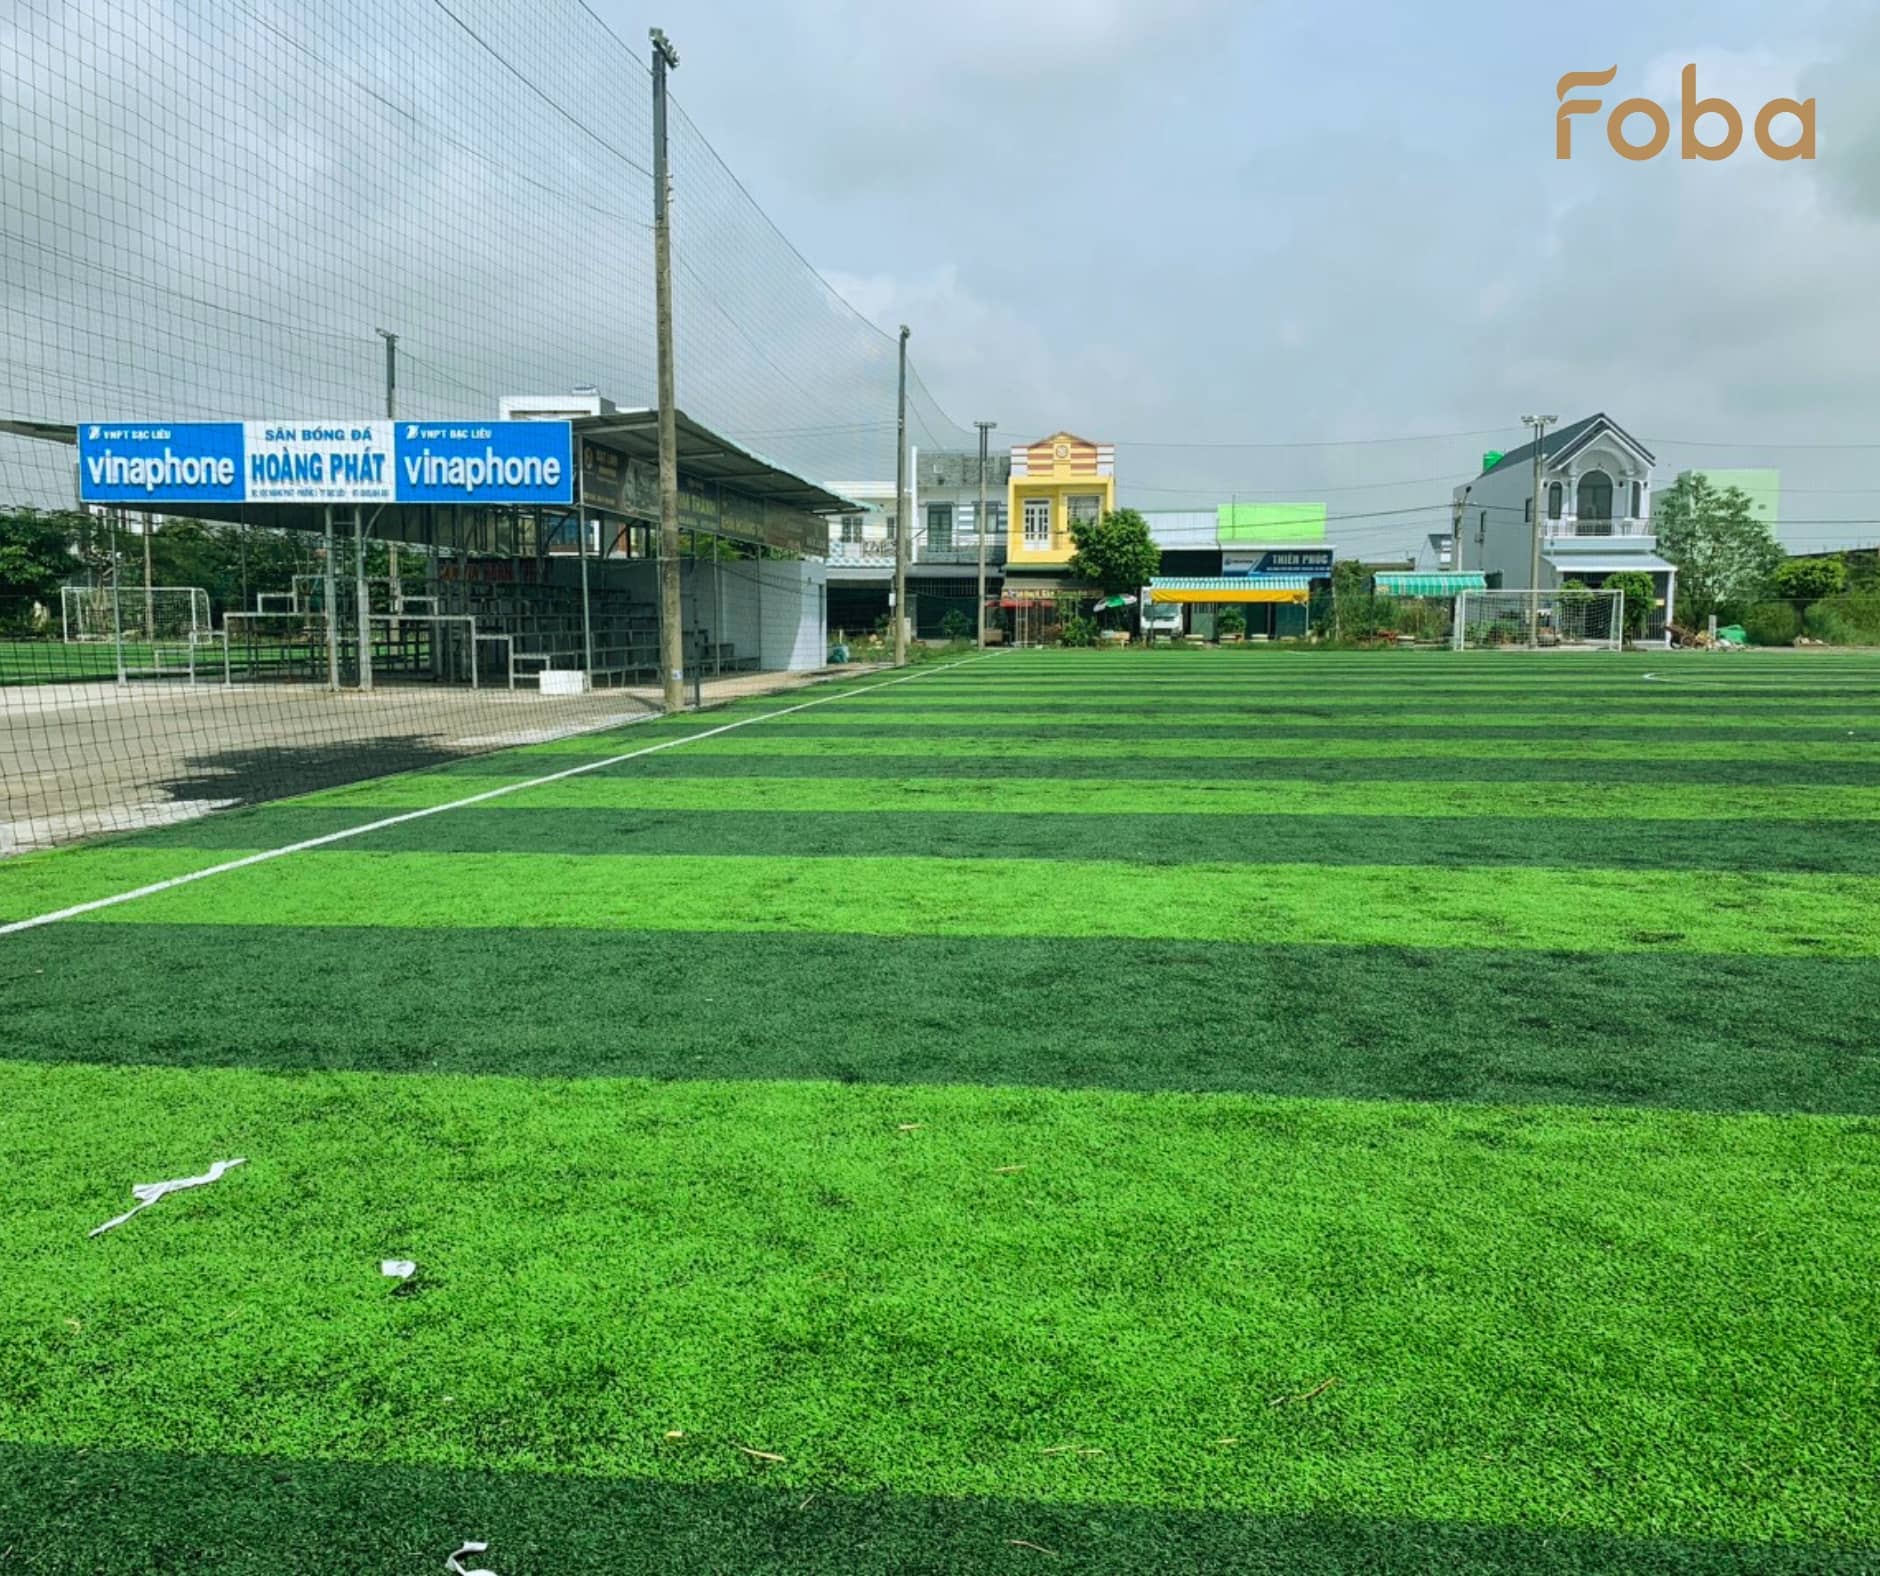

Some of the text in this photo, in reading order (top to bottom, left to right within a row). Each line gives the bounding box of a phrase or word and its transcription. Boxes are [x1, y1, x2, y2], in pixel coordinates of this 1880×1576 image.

[103, 430, 129, 440] VNPT
[301, 425, 346, 442] BÓNG
[351, 425, 373, 442] ĐÁ
[421, 429, 447, 440] VNPT
[87, 447, 235, 492] vinaphone
[251, 446, 386, 484] HOÀNG PHÁT
[404, 446, 561, 492] vinaphone
